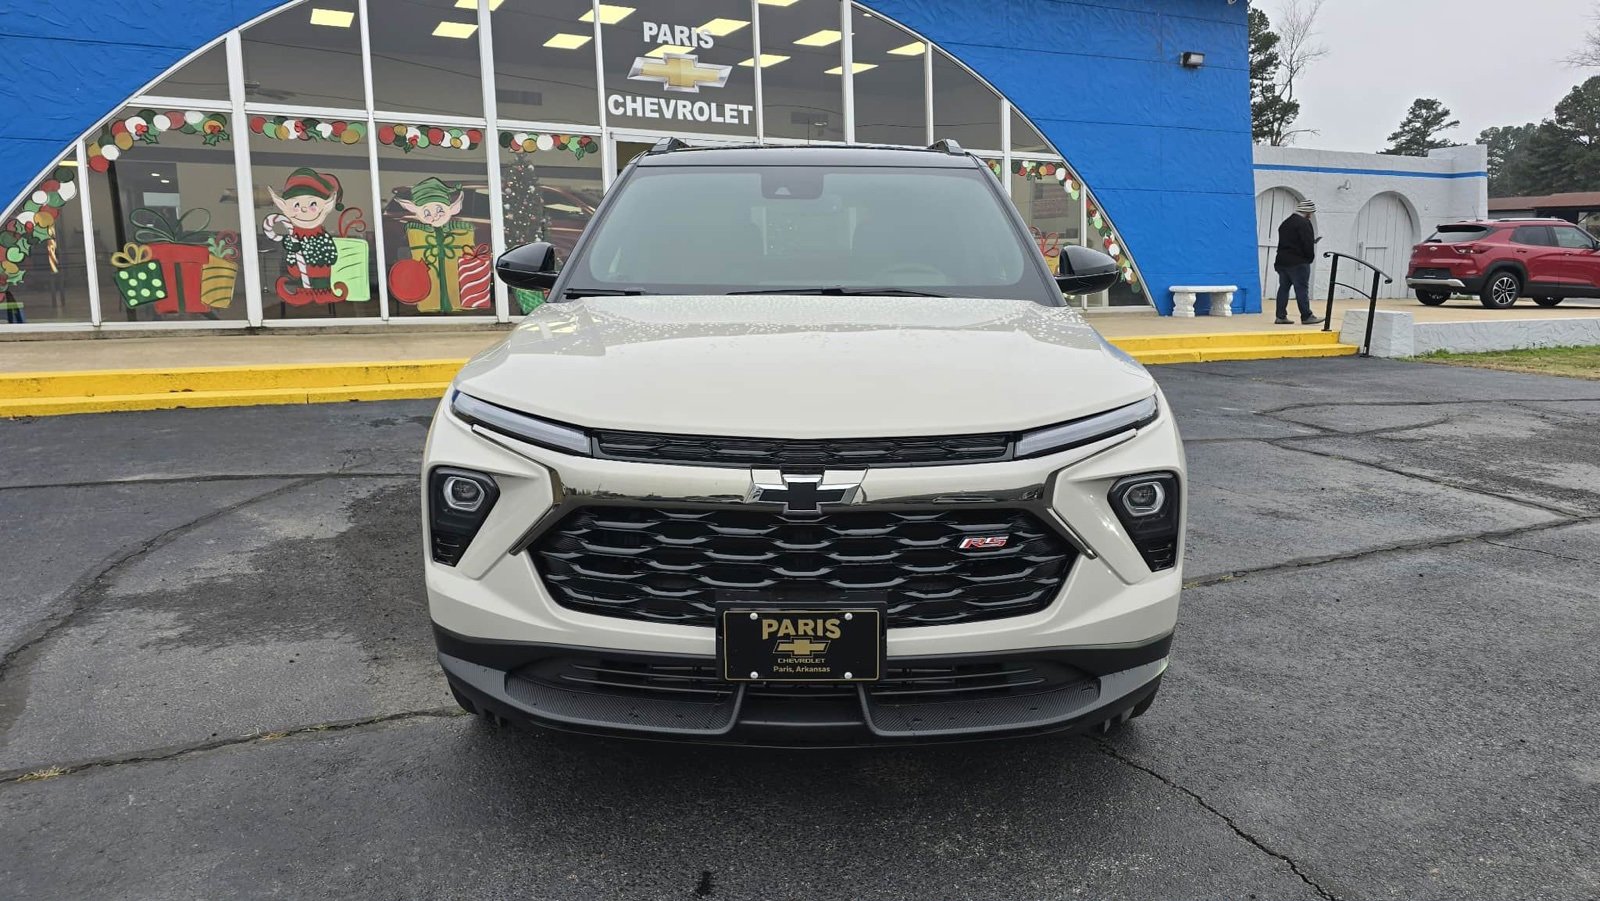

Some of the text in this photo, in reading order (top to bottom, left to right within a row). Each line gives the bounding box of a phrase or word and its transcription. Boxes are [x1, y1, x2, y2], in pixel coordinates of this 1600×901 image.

[643, 21, 714, 49] PARIS
[607, 94, 753, 125] CHEVROLET
[959, 536, 1009, 549] RS
[761, 618, 841, 640] PARIS
